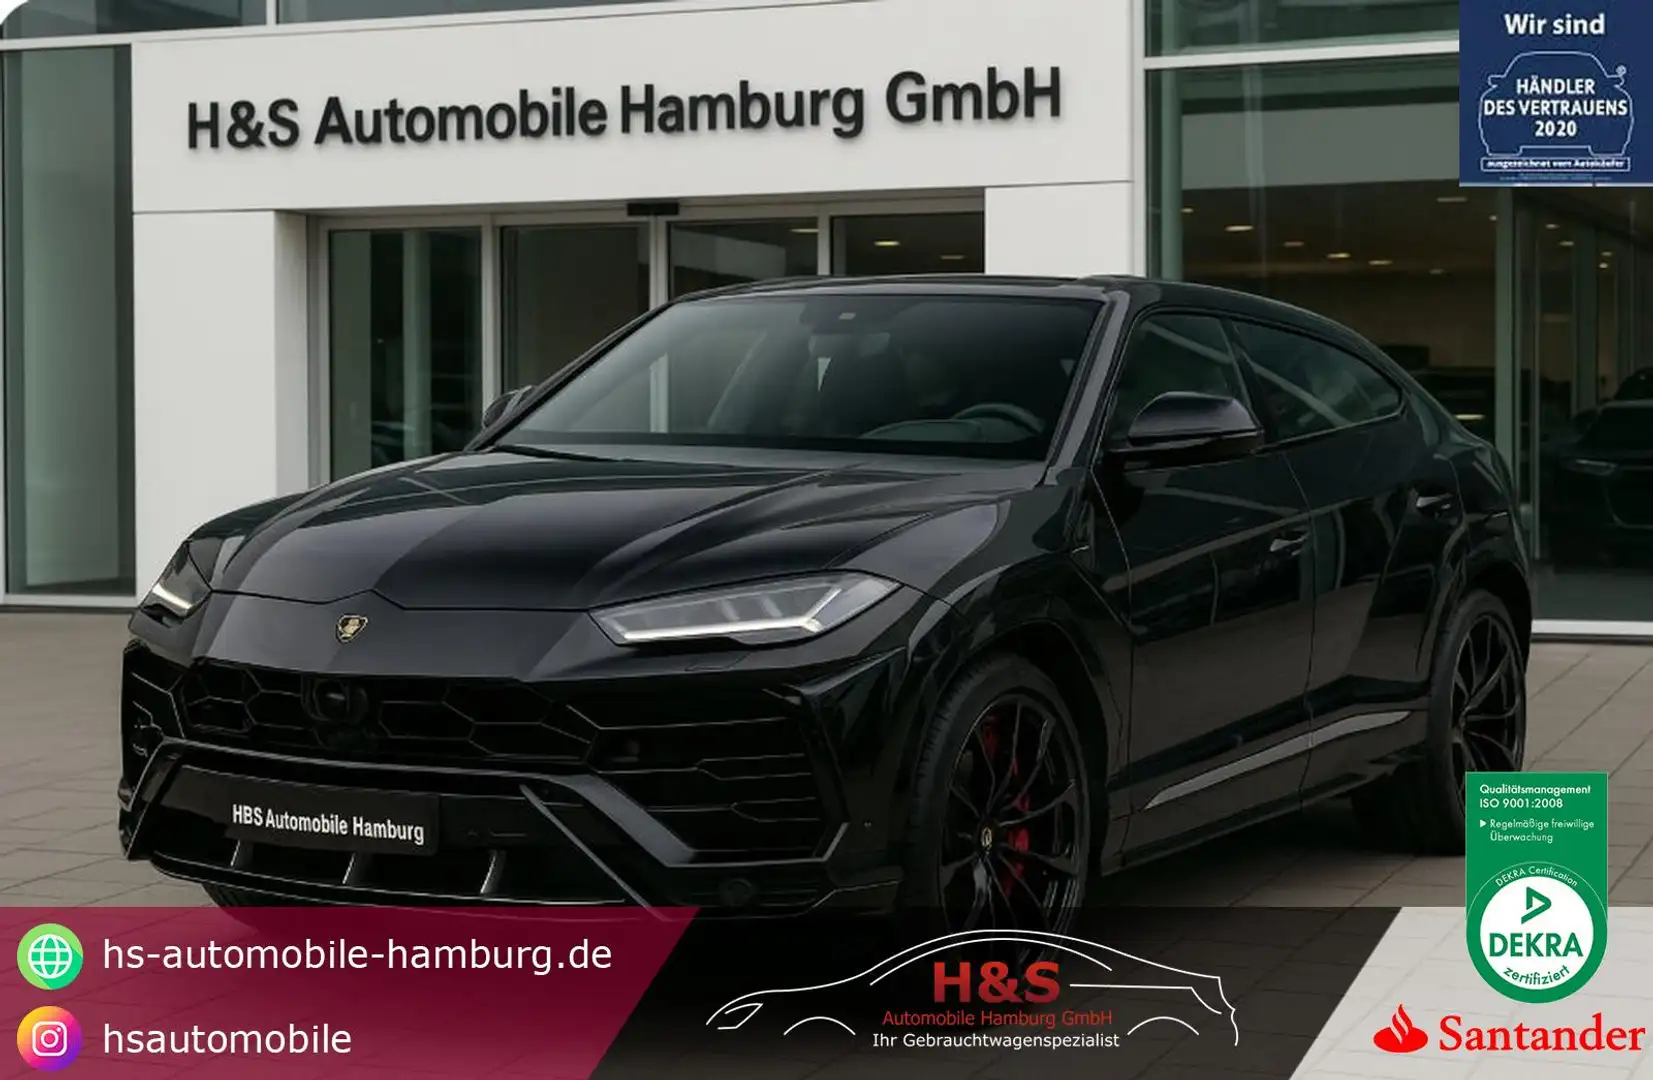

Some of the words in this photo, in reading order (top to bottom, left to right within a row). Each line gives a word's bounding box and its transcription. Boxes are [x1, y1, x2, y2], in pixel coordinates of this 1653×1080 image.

[187, 98, 301, 149] H&S
[314, 86, 608, 145] Automobile
[620, 82, 866, 138] Hamburg
[885, 66, 1062, 124] GmbH
[232, 804, 264, 826] HBS
[265, 809, 348, 835] Automobile
[352, 816, 425, 846] Hamburg
